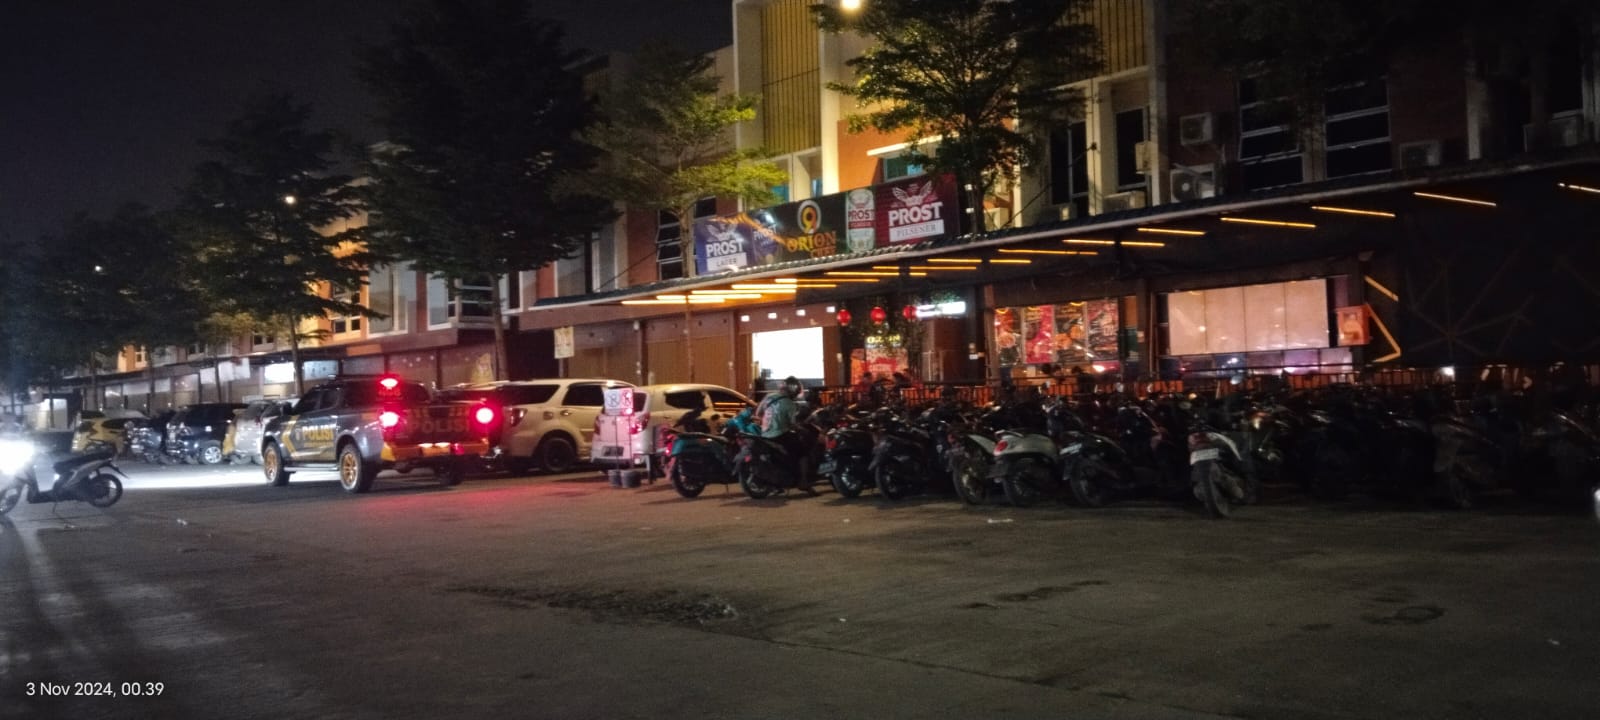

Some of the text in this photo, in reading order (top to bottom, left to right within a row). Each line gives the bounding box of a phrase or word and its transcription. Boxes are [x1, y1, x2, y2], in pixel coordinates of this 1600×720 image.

[888, 201, 943, 227] PROST
[897, 224, 936, 237] PILSENER
[705, 238, 744, 258] PROST
[786, 230, 836, 253] ORION
